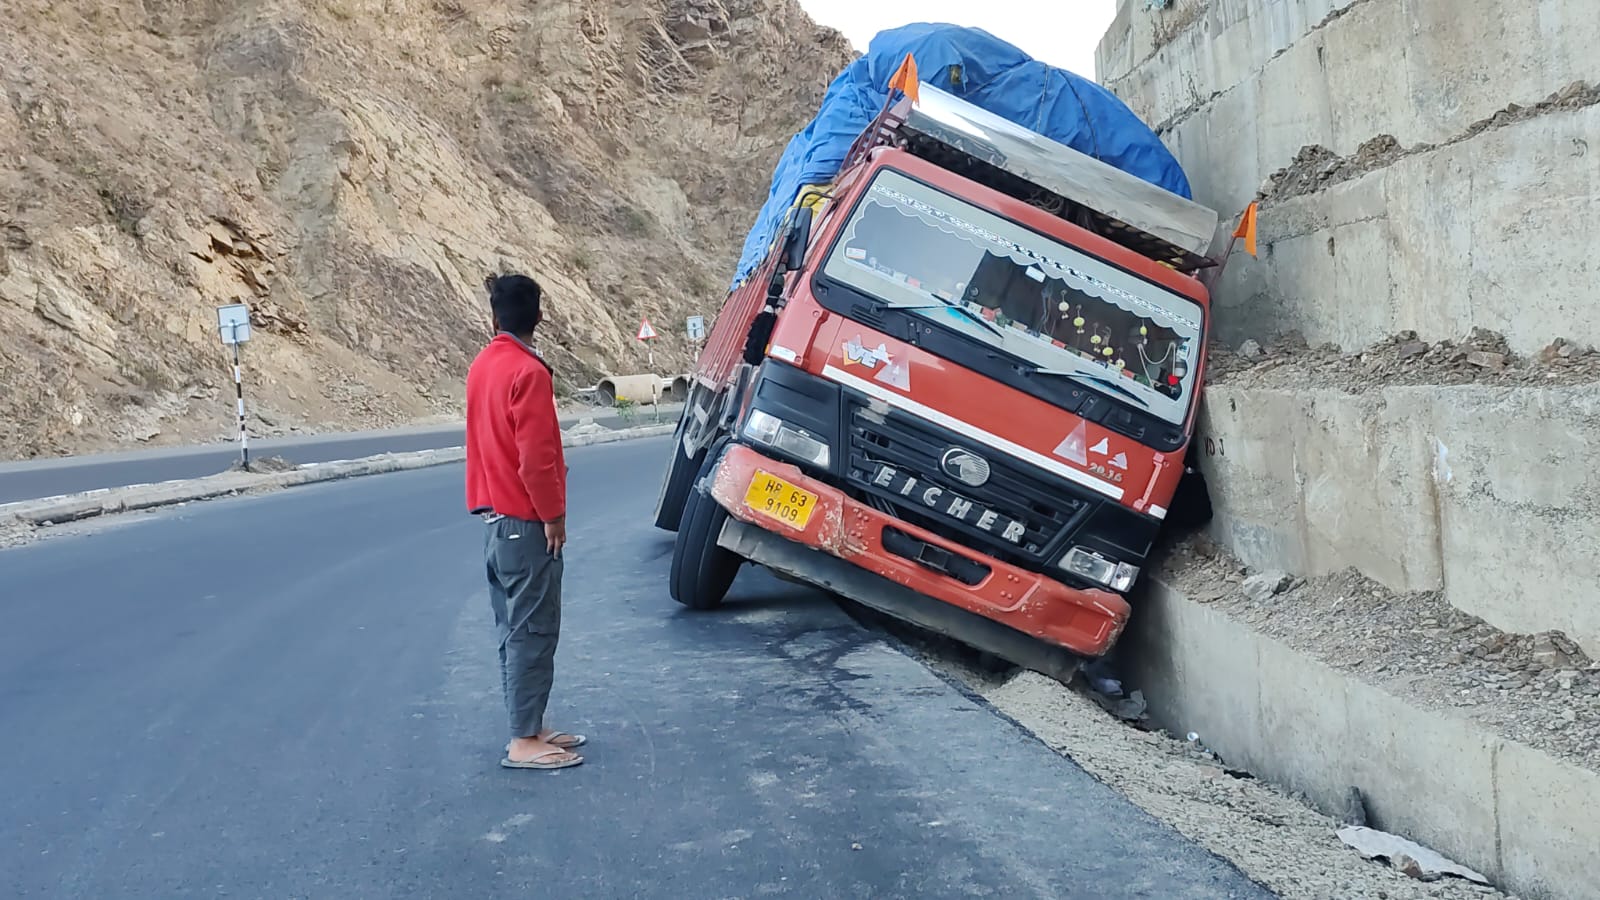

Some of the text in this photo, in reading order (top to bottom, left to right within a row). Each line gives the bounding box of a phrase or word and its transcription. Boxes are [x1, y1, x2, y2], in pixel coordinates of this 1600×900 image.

[765, 498, 798, 521] 9109
[790, 491, 808, 507] 63
[874, 465, 1026, 543] EICHER
